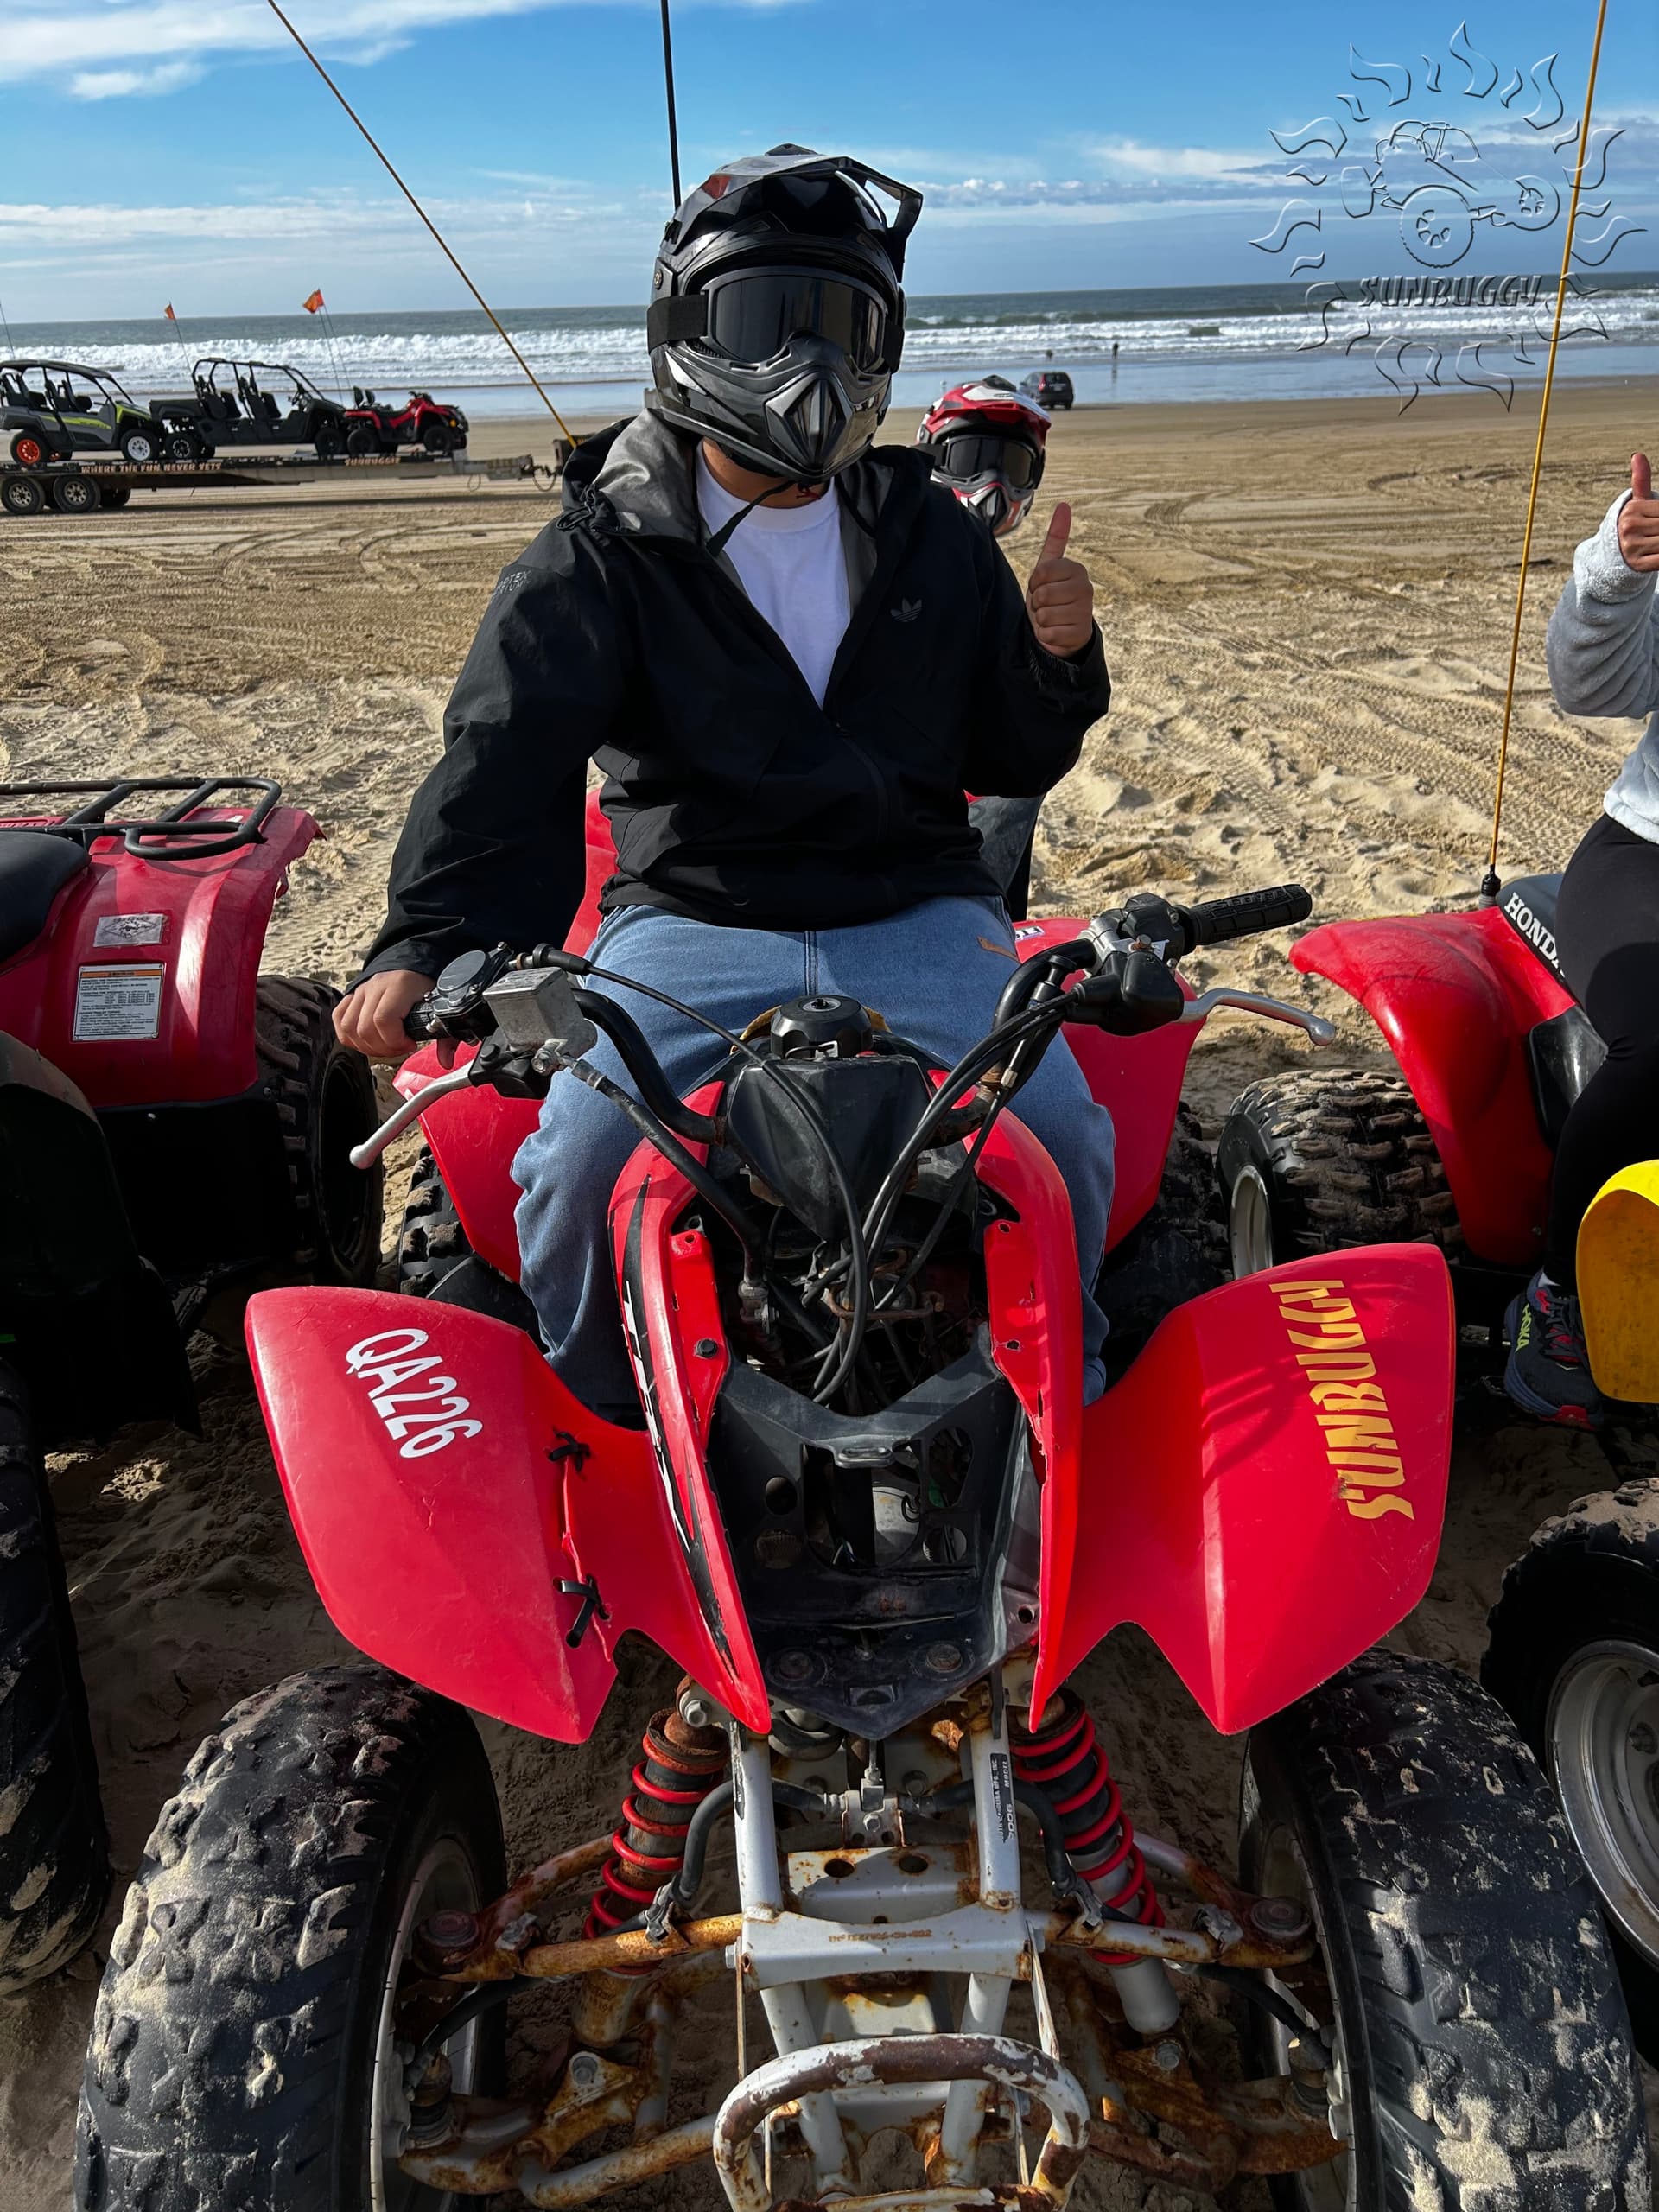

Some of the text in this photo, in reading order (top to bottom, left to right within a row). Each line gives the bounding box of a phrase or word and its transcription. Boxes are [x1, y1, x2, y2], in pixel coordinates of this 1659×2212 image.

[80, 464, 116, 474] WHERE
[163, 461, 195, 472] NEVER
[1503, 892, 1565, 977] HOND
[1515, 1303, 1532, 1353] HOKA
[346, 1328, 483, 1459] QA226
[1269, 1280, 1414, 1520] SUNBUGGY
